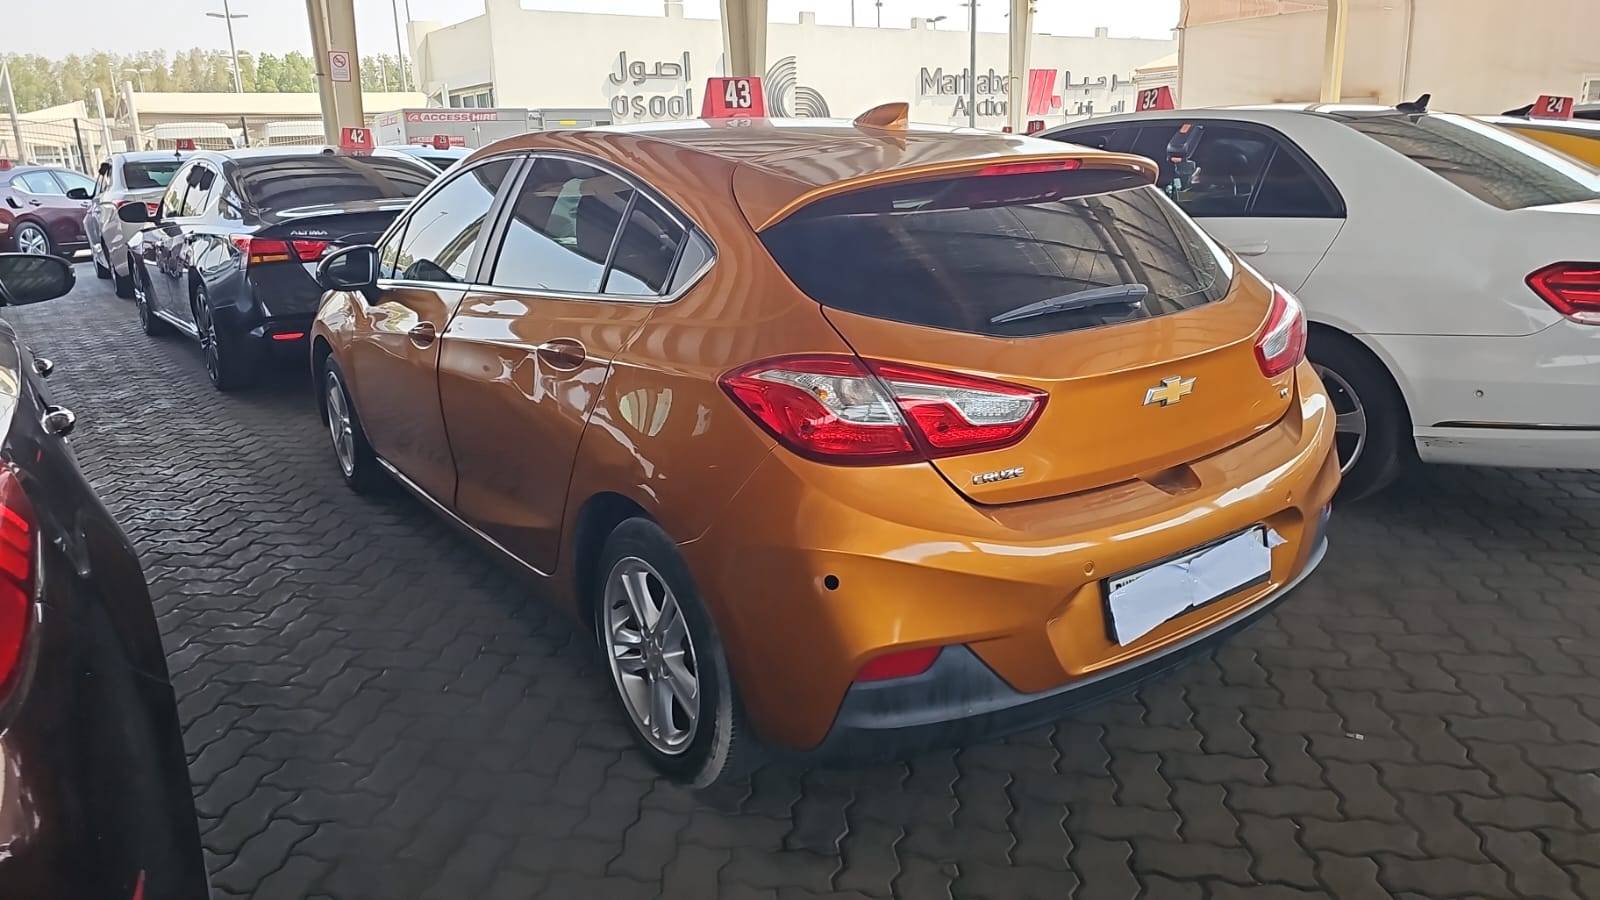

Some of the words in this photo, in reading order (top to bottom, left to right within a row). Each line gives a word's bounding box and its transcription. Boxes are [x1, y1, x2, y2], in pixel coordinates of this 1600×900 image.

[609, 51, 691, 86] اصول
[1065, 70, 1131, 95] رحبا
[725, 80, 752, 108] 43
[1143, 89, 1159, 110] 32
[1547, 98, 1564, 112] 24
[423, 113, 468, 121] ACCESS
[472, 113, 497, 121] HIRE
[351, 129, 365, 144] 42
[972, 467, 1025, 485] CRUZE
